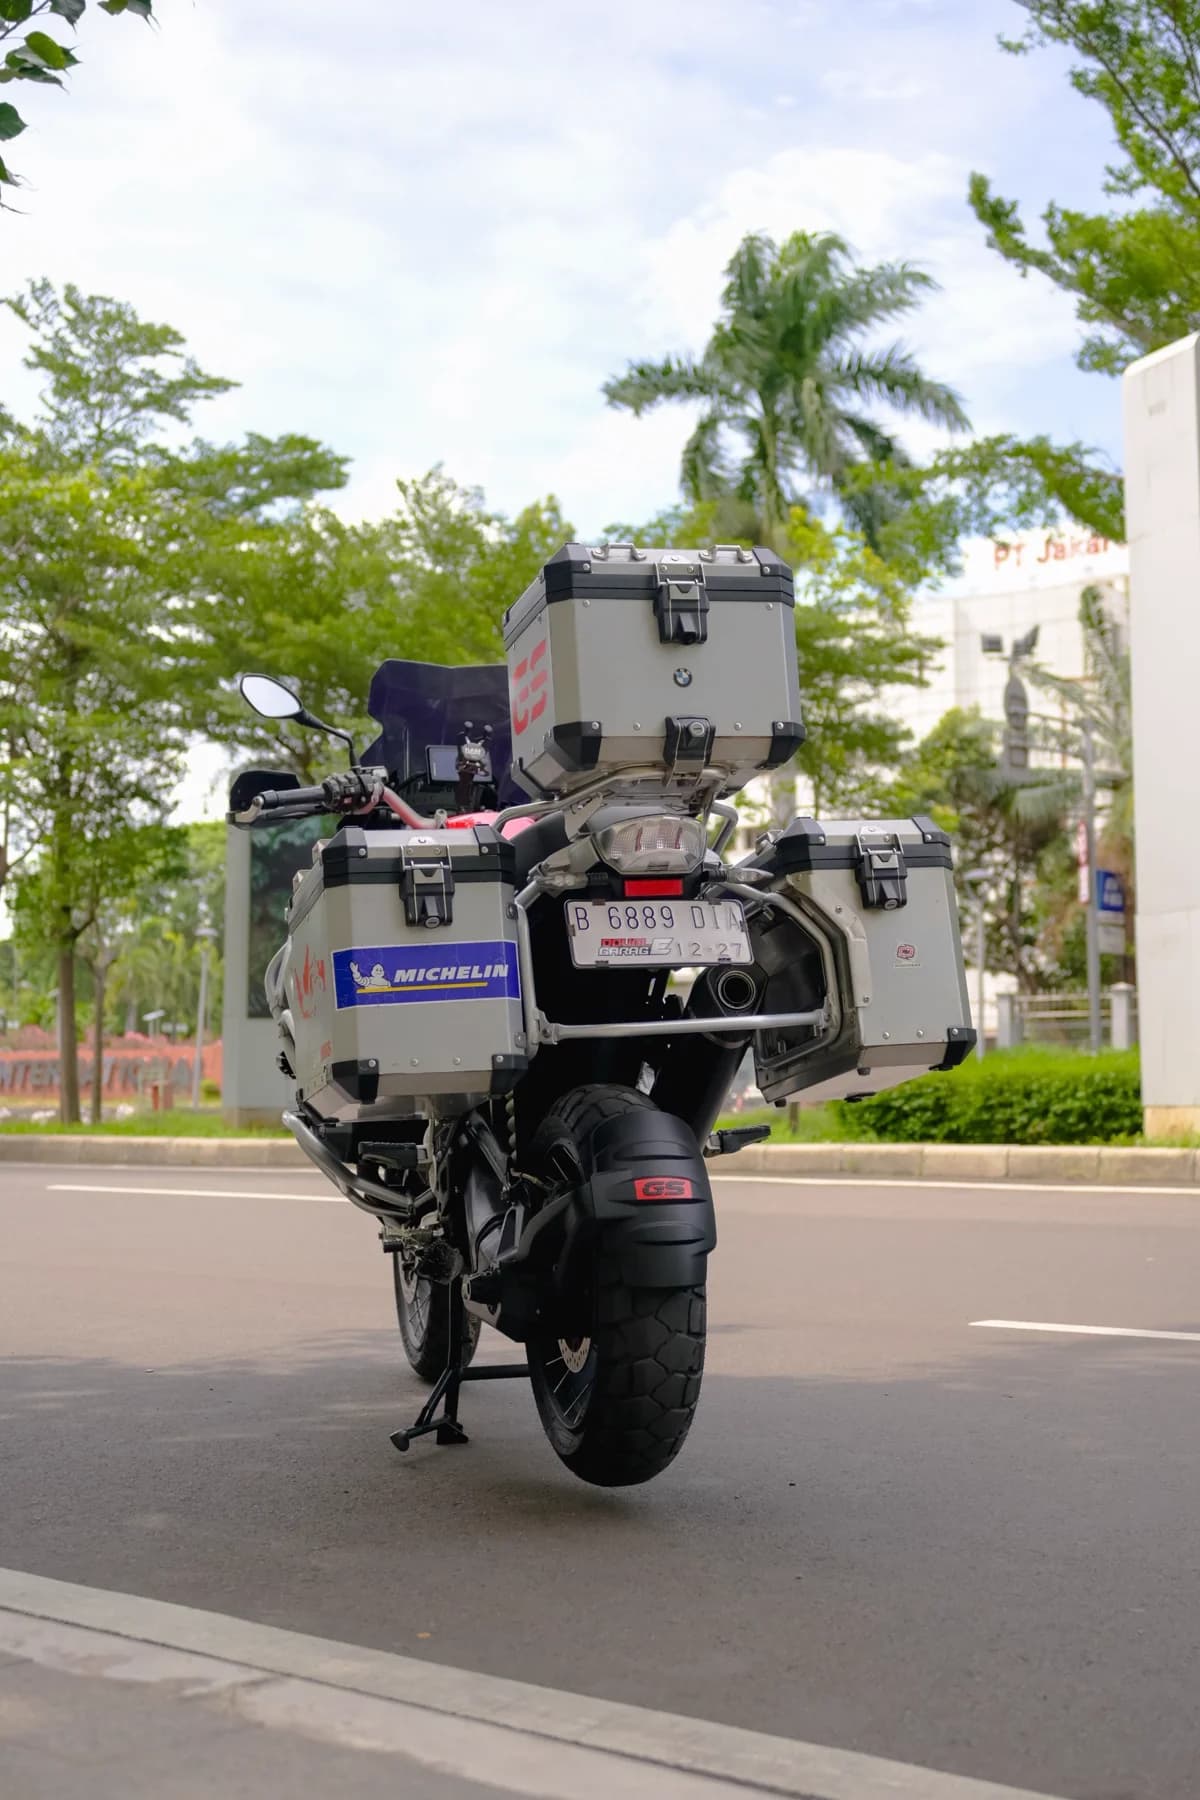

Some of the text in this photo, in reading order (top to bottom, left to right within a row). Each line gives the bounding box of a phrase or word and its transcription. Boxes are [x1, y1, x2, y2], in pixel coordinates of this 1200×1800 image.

[575, 907, 590, 930] B
[607, 906, 674, 930] 6889
[394, 964, 509, 983] MICHELIN
[643, 1181, 685, 1196] GS
